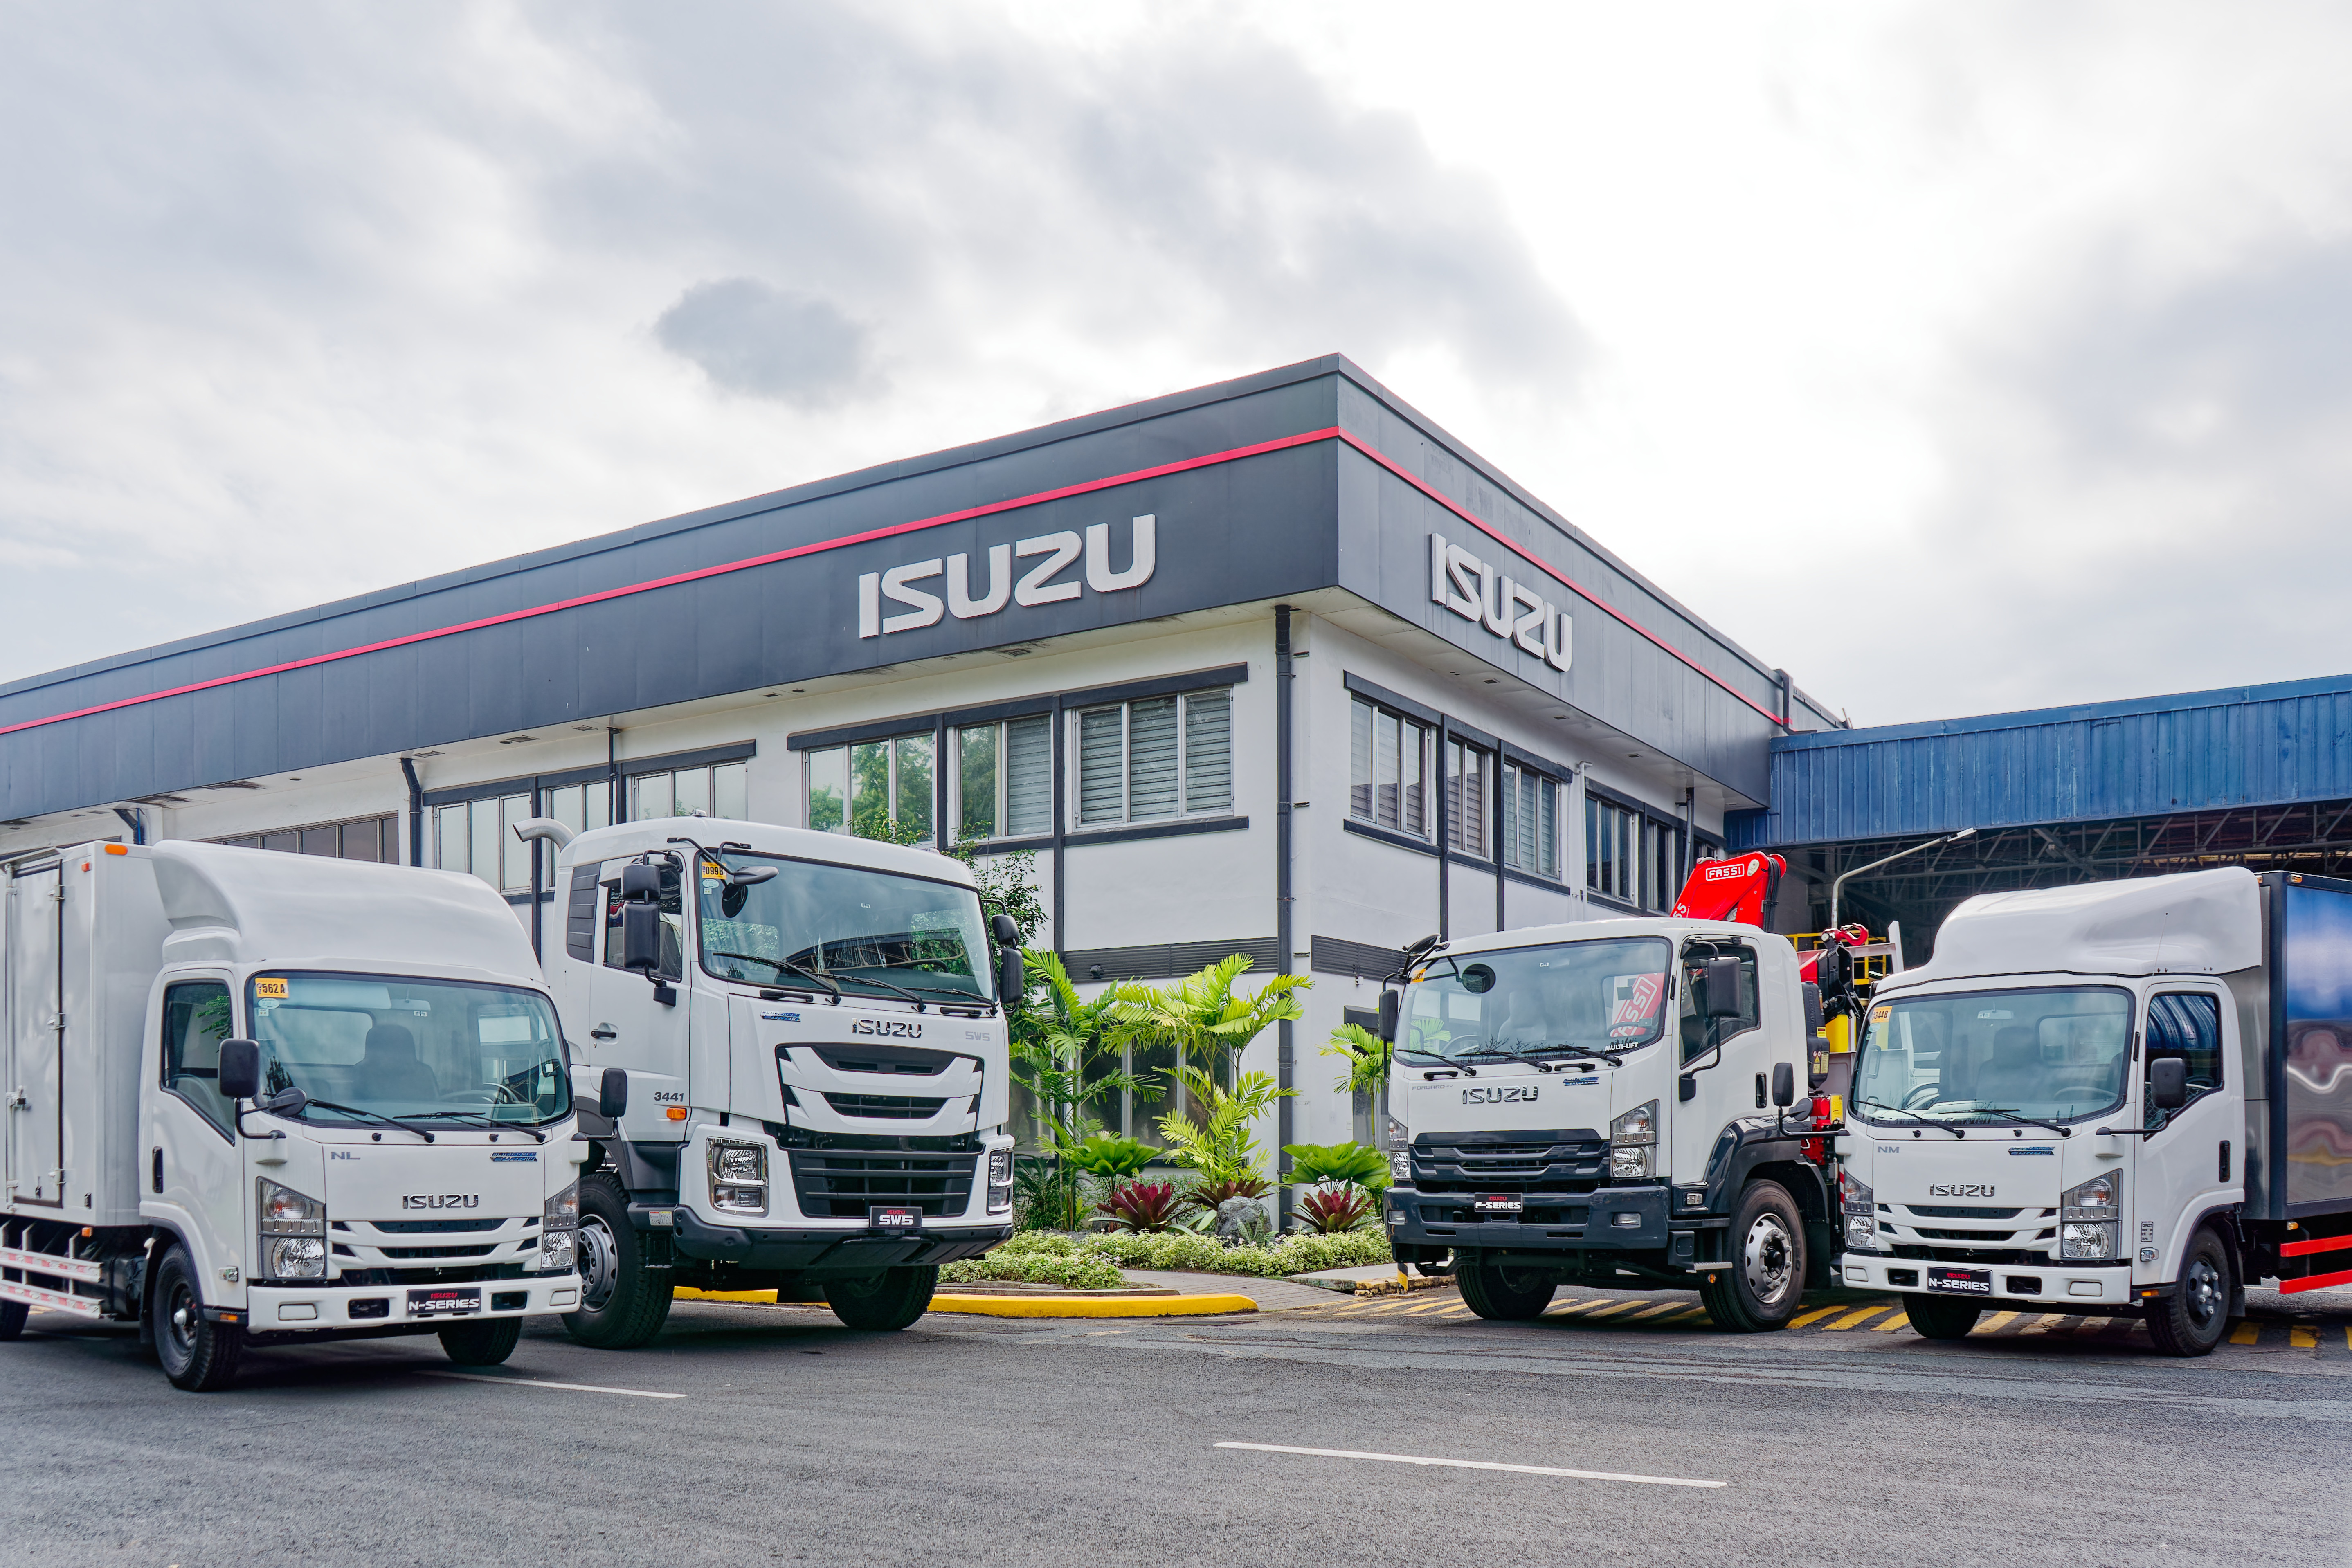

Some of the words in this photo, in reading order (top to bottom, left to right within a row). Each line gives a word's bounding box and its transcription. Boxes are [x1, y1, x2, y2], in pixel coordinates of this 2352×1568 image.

[859, 514, 1156, 638] ISUZU
[1432, 532, 1572, 672] ISUZU
[1709, 866, 1741, 878] FASSI
[852, 1018, 922, 1038] ISUZU
[1605, 1042, 1639, 1051] MULTI-LIFT
[654, 1092, 684, 1102] 3441
[1462, 1084, 1539, 1104] ISUZU
[331, 1152, 360, 1160] NL
[1930, 1183, 1995, 1197] ISUZU
[402, 1193, 479, 1209] ISUZU
[1928, 1278, 1990, 1291] N-SERIES
[408, 1298, 479, 1311] N-SERIES
